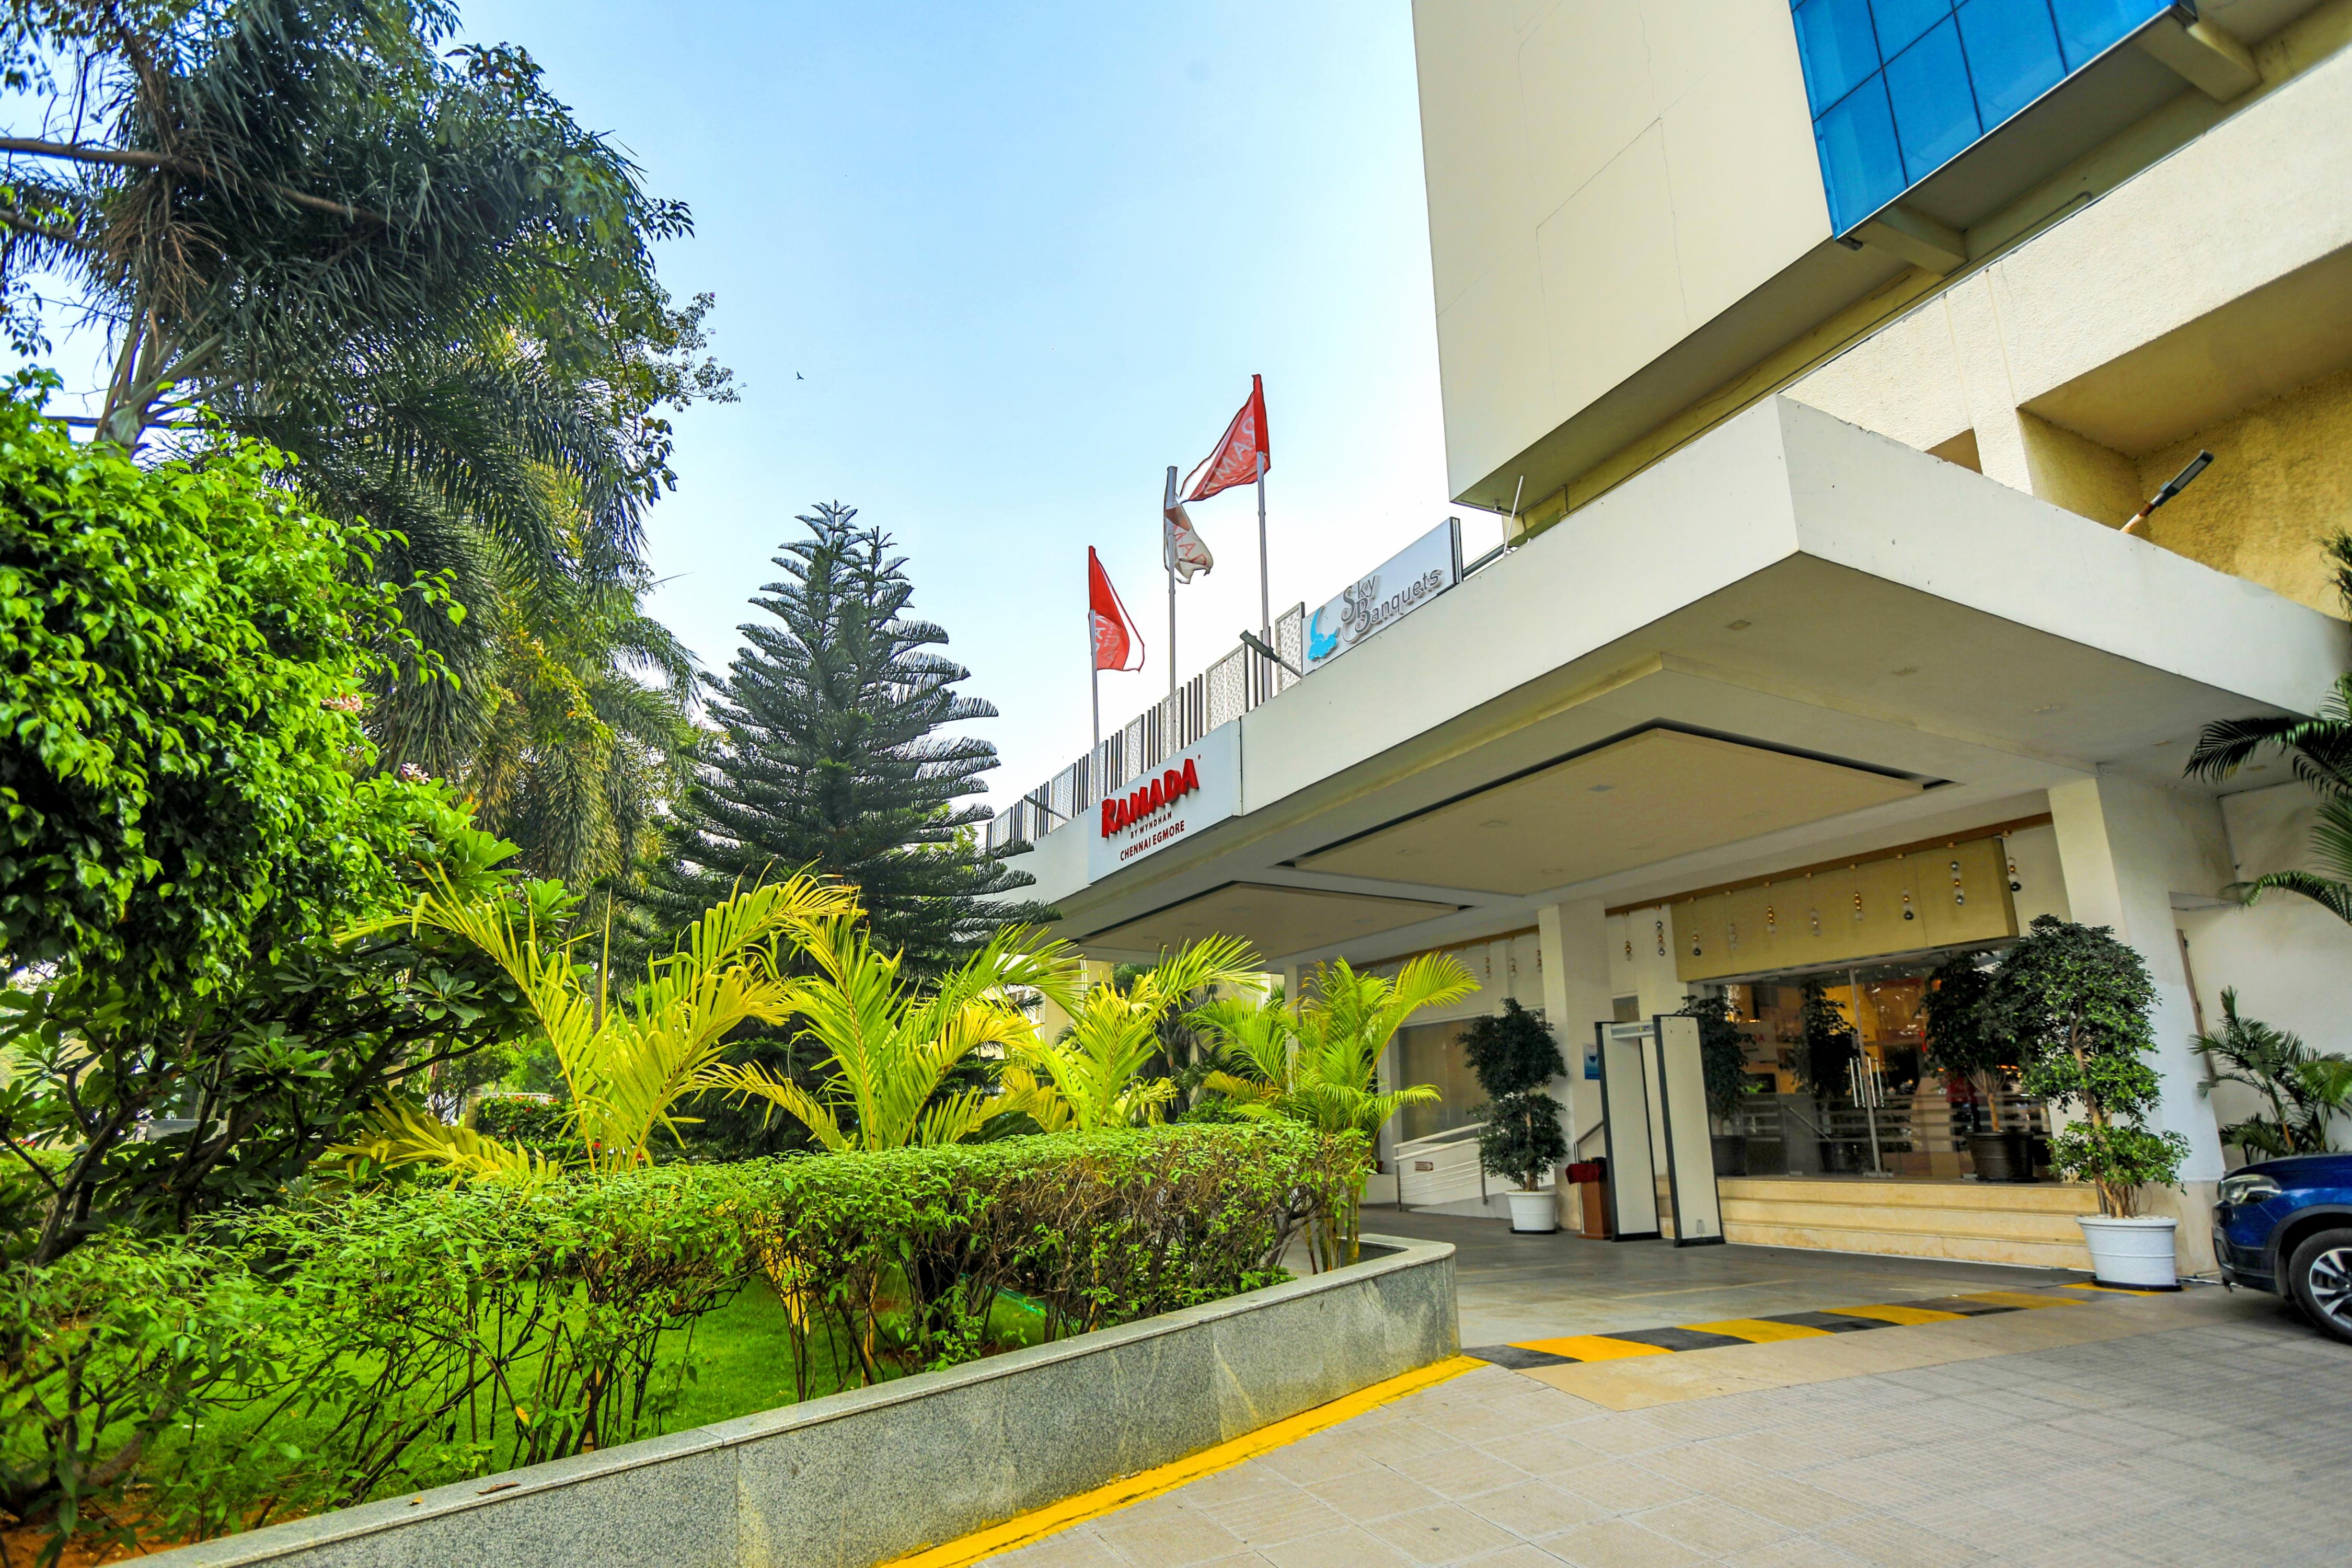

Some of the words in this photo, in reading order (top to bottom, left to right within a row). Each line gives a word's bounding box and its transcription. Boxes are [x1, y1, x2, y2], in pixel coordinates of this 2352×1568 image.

[1341, 575, 1379, 622] Sky
[1342, 569, 1442, 643] Banquets
[1101, 758, 1200, 838] RAMADA
[1120, 837, 1151, 861] CHENNAI
[1153, 821, 1184, 846] EGMORE
[1131, 830, 1138, 838] BY
[1139, 811, 1172, 833] WYNDHAM
